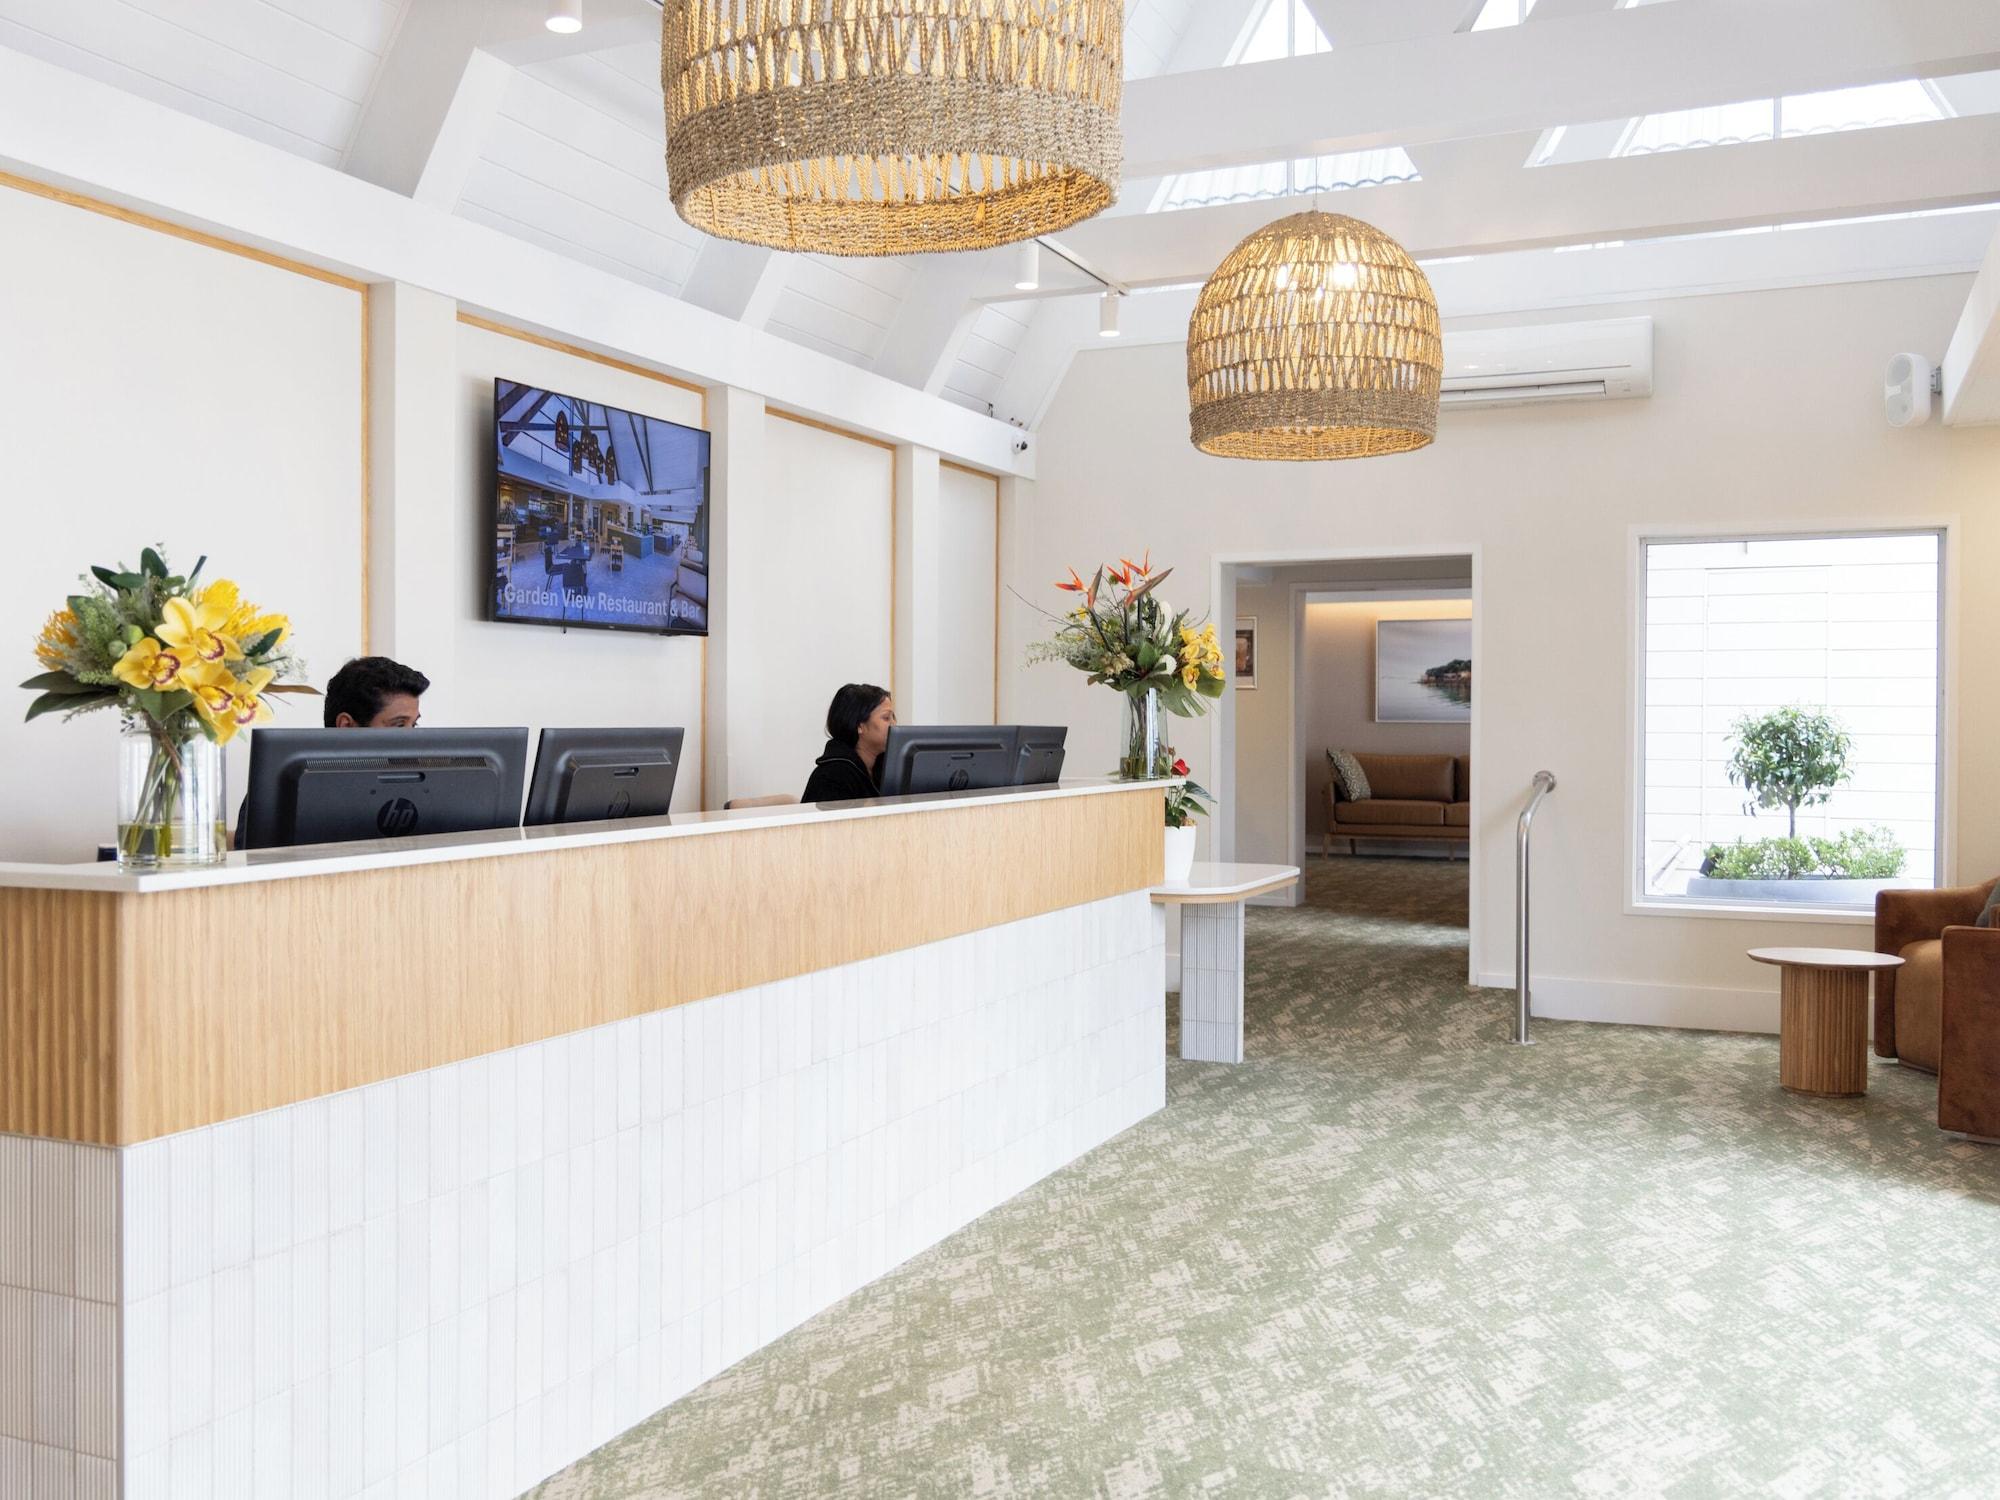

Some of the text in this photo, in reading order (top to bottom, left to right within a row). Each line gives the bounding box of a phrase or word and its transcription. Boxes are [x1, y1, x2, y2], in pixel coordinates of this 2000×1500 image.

[504, 583, 701, 619] Garden View Restaurant & Bar
[381, 798, 416, 836] hp
